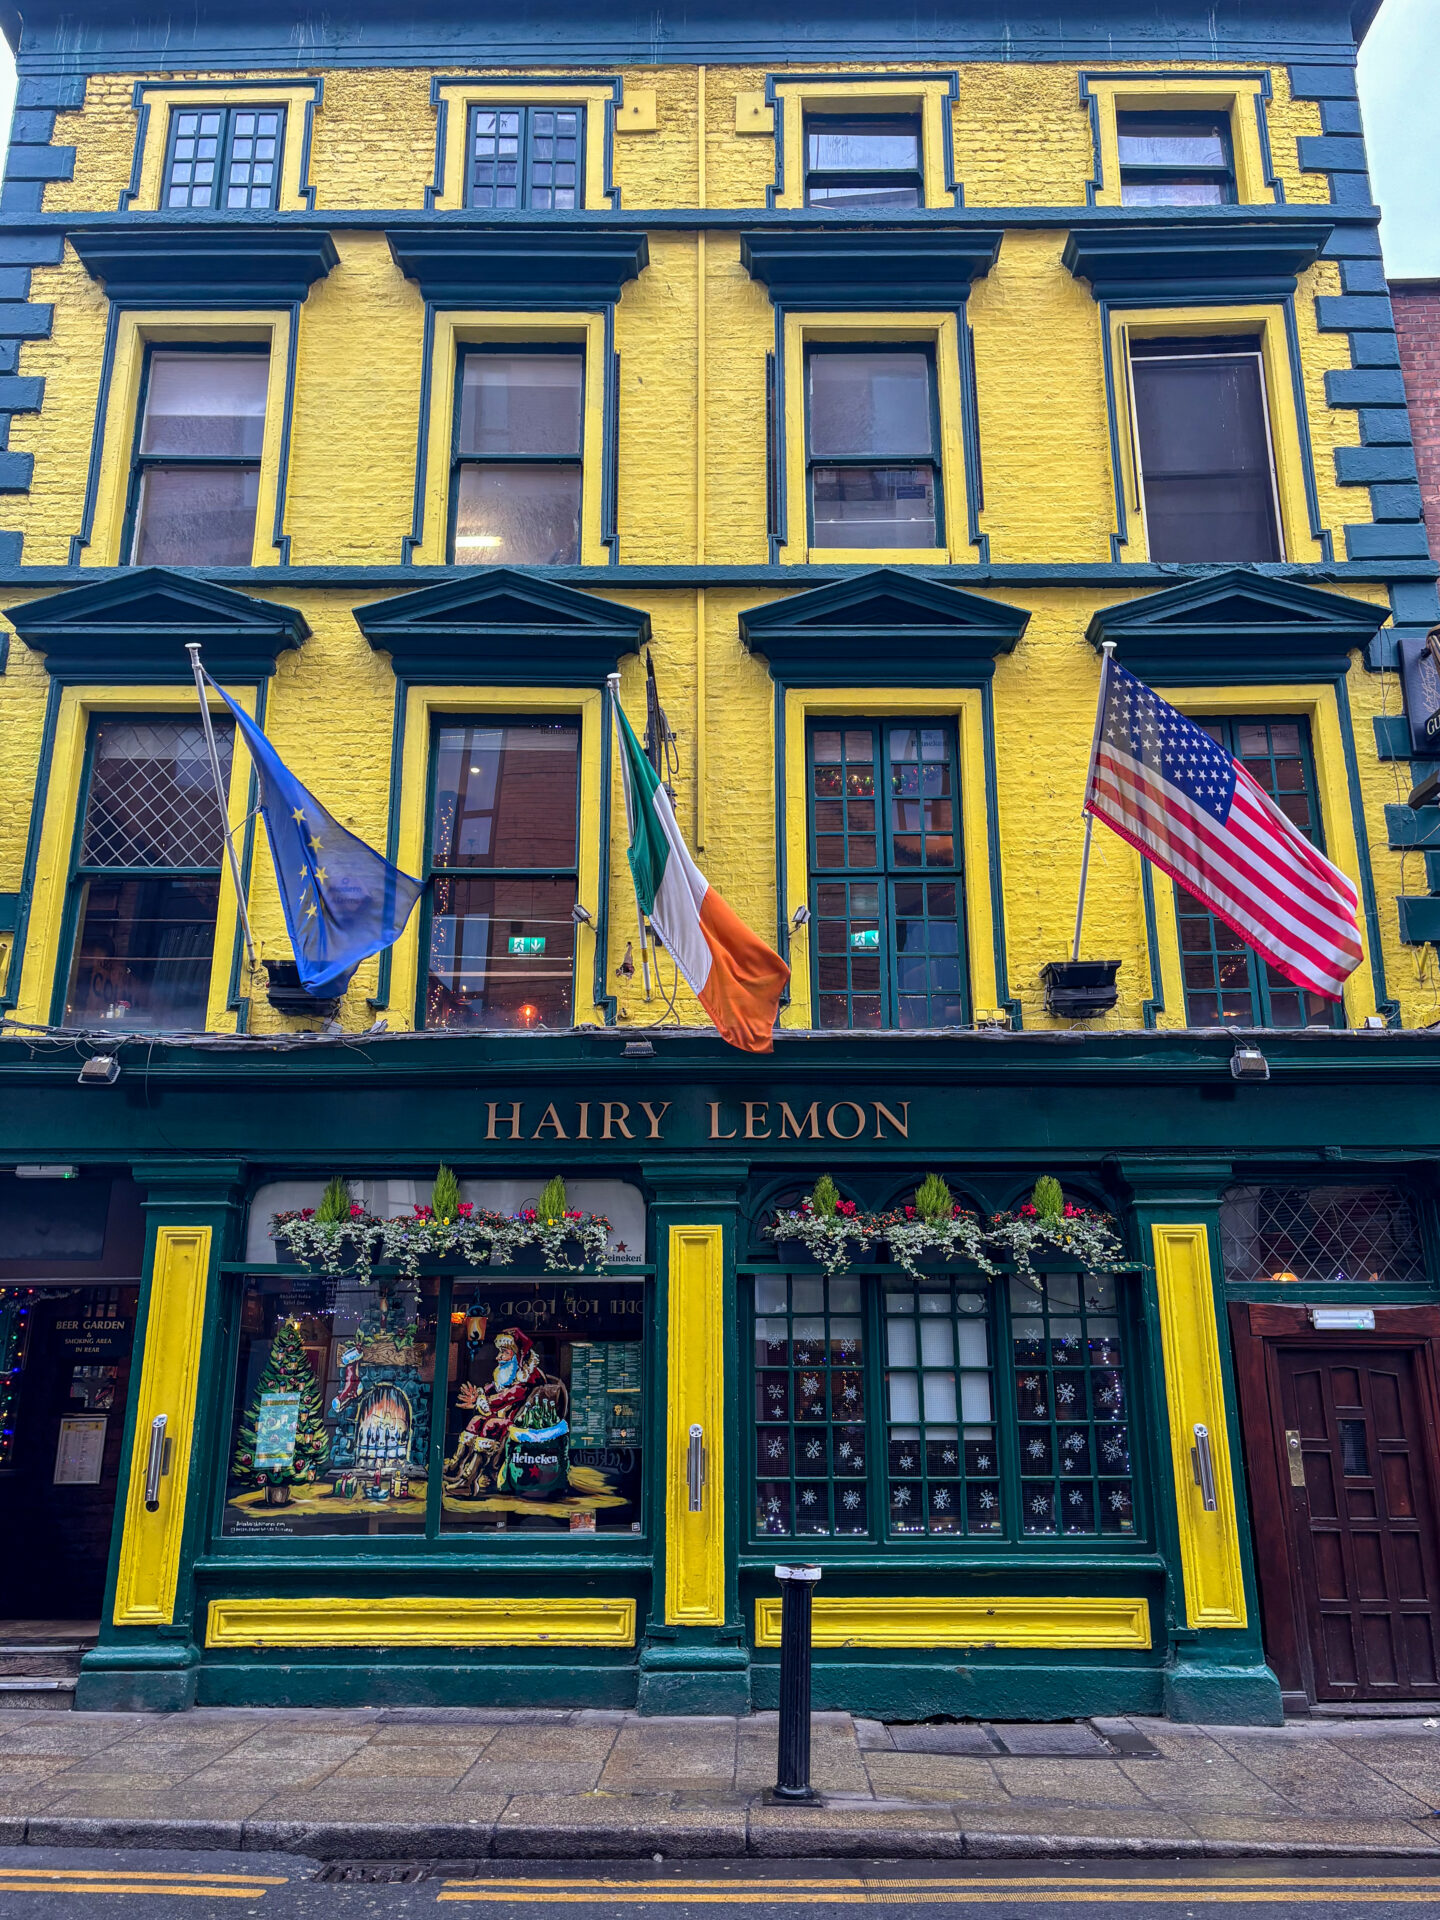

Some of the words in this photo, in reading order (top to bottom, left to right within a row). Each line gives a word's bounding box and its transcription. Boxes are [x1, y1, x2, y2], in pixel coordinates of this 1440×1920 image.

[483, 1101, 674, 1140] HAIRY
[707, 1101, 911, 1140] LEMON
[56, 1320, 78, 1330] BEER
[83, 1320, 125, 1330] GARDEN
[512, 1452, 558, 1465] Heineken
